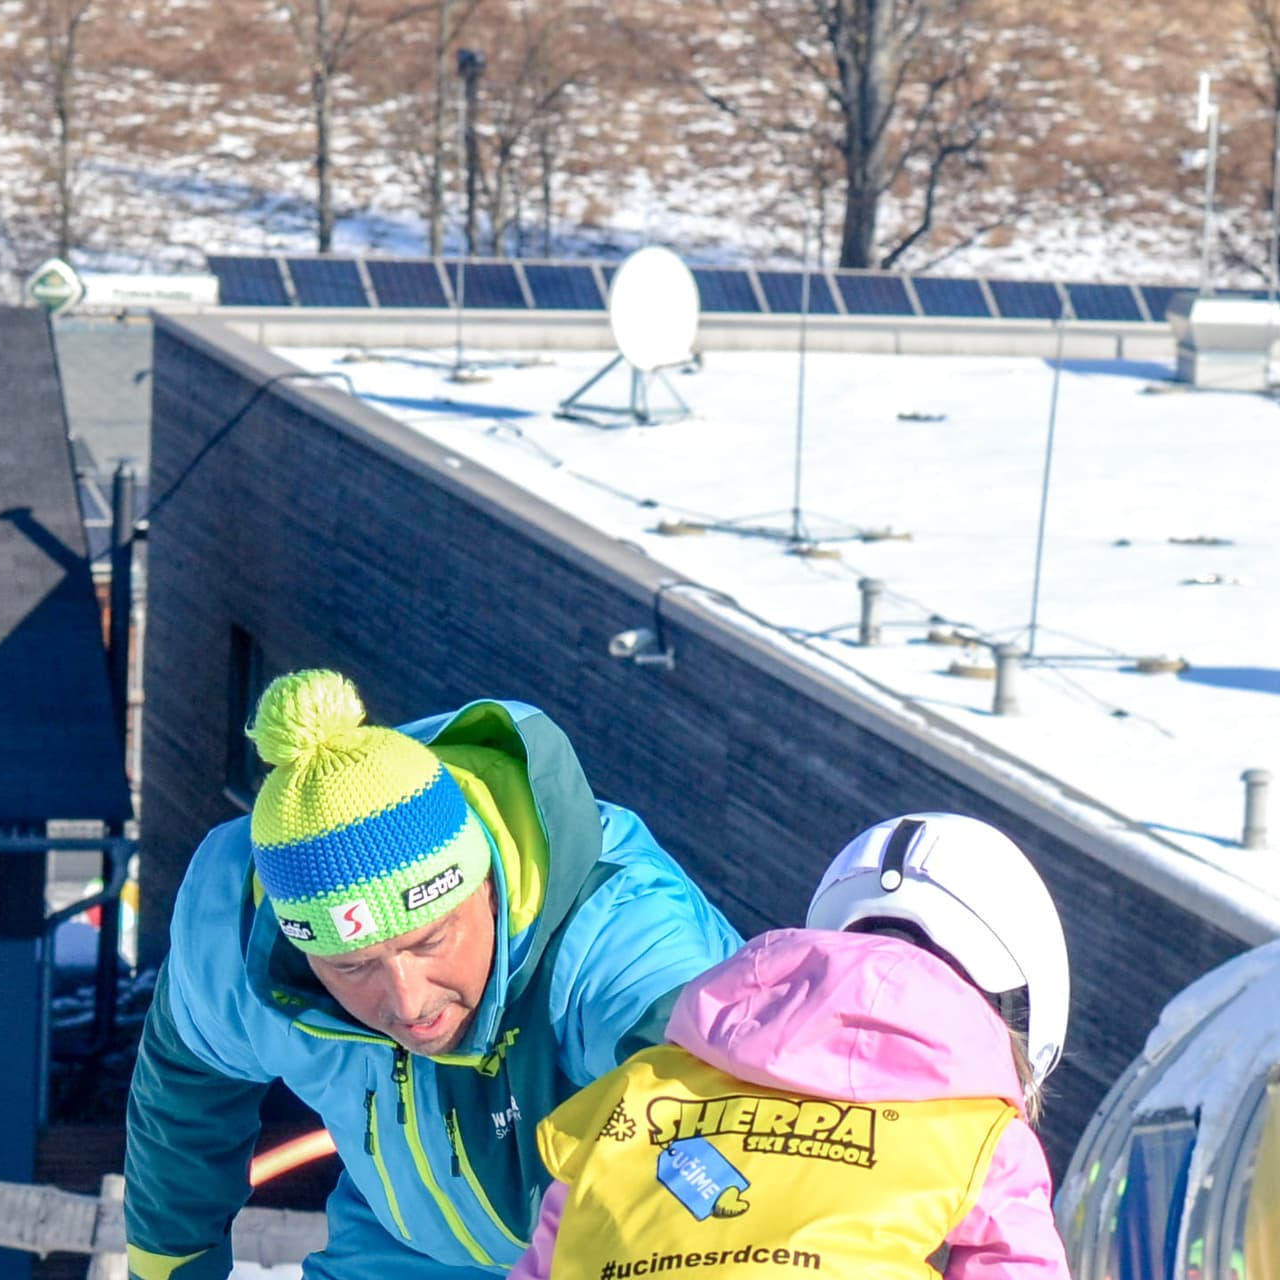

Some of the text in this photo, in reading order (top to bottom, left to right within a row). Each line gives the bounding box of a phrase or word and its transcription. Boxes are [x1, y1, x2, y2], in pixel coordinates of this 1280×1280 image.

[646, 1094, 877, 1149] SHERPA
[746, 1135, 872, 1167] SKI SCHOOL
